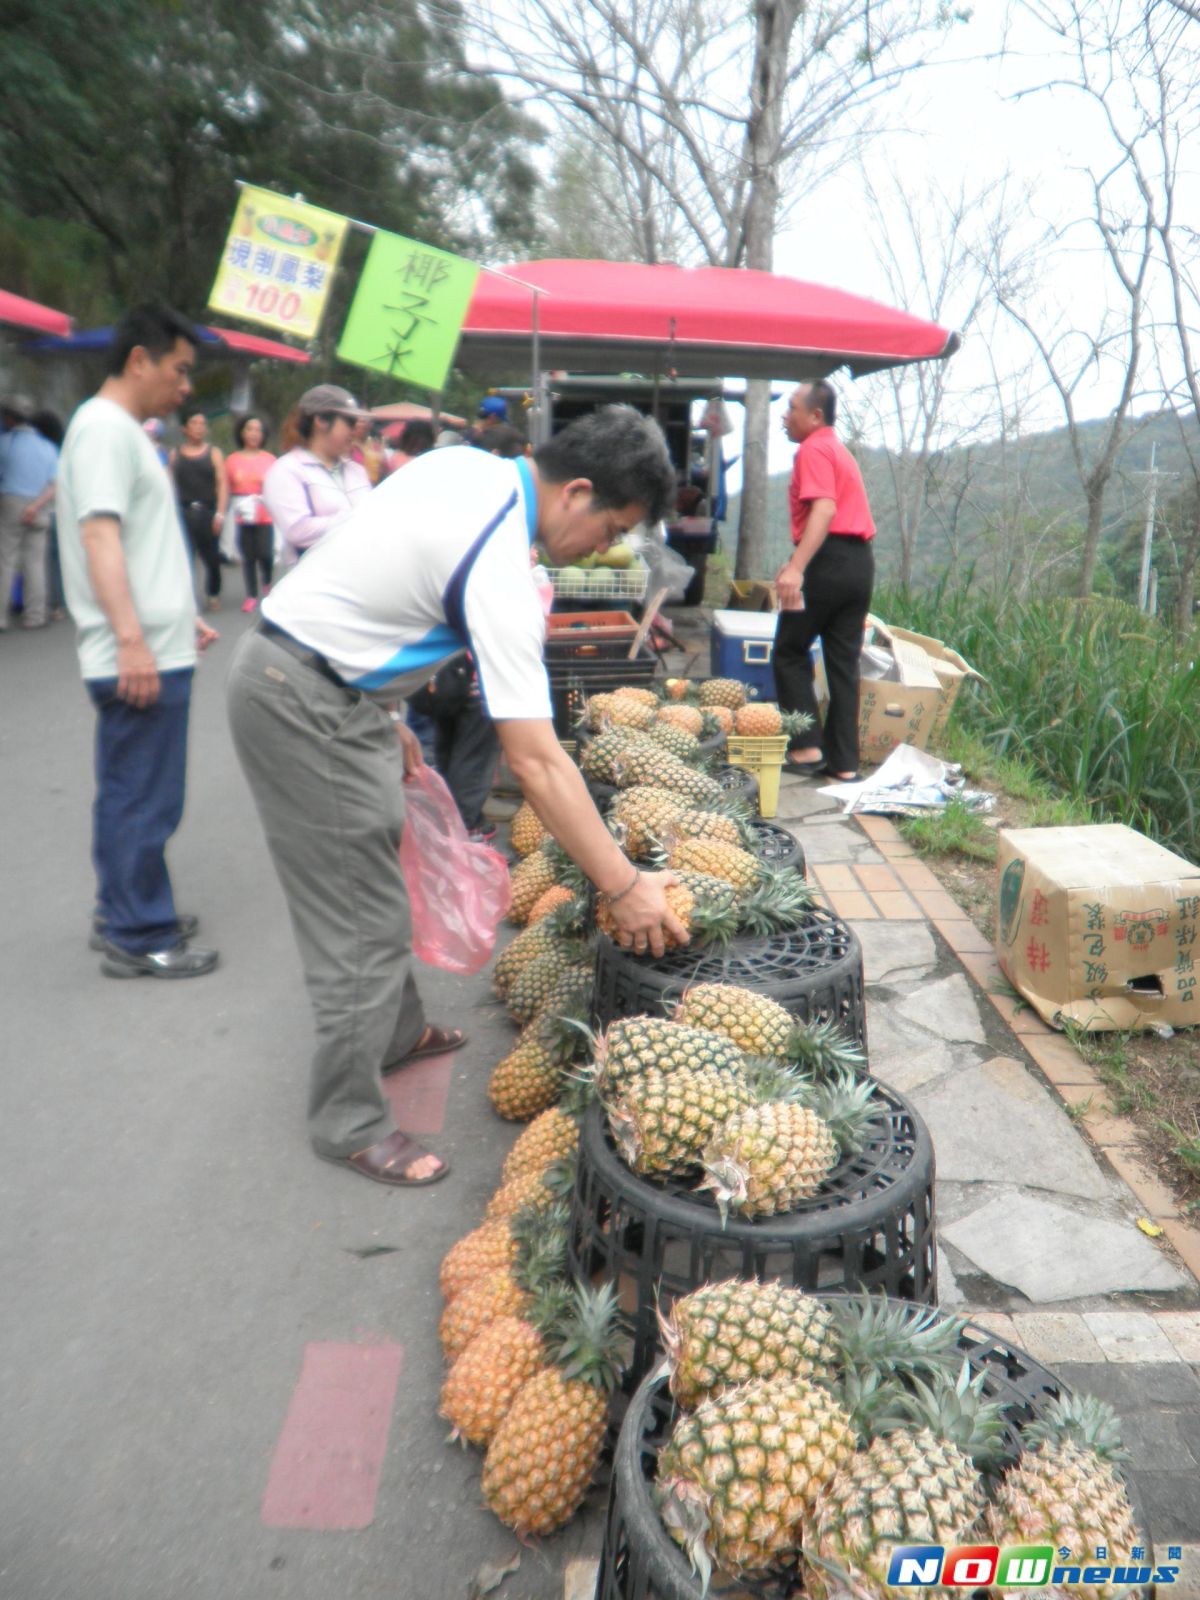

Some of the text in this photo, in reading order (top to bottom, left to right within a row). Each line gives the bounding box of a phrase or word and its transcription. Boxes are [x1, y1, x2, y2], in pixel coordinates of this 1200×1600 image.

[245, 282, 302, 321] 100
[368, 250, 452, 375] 椰子水
